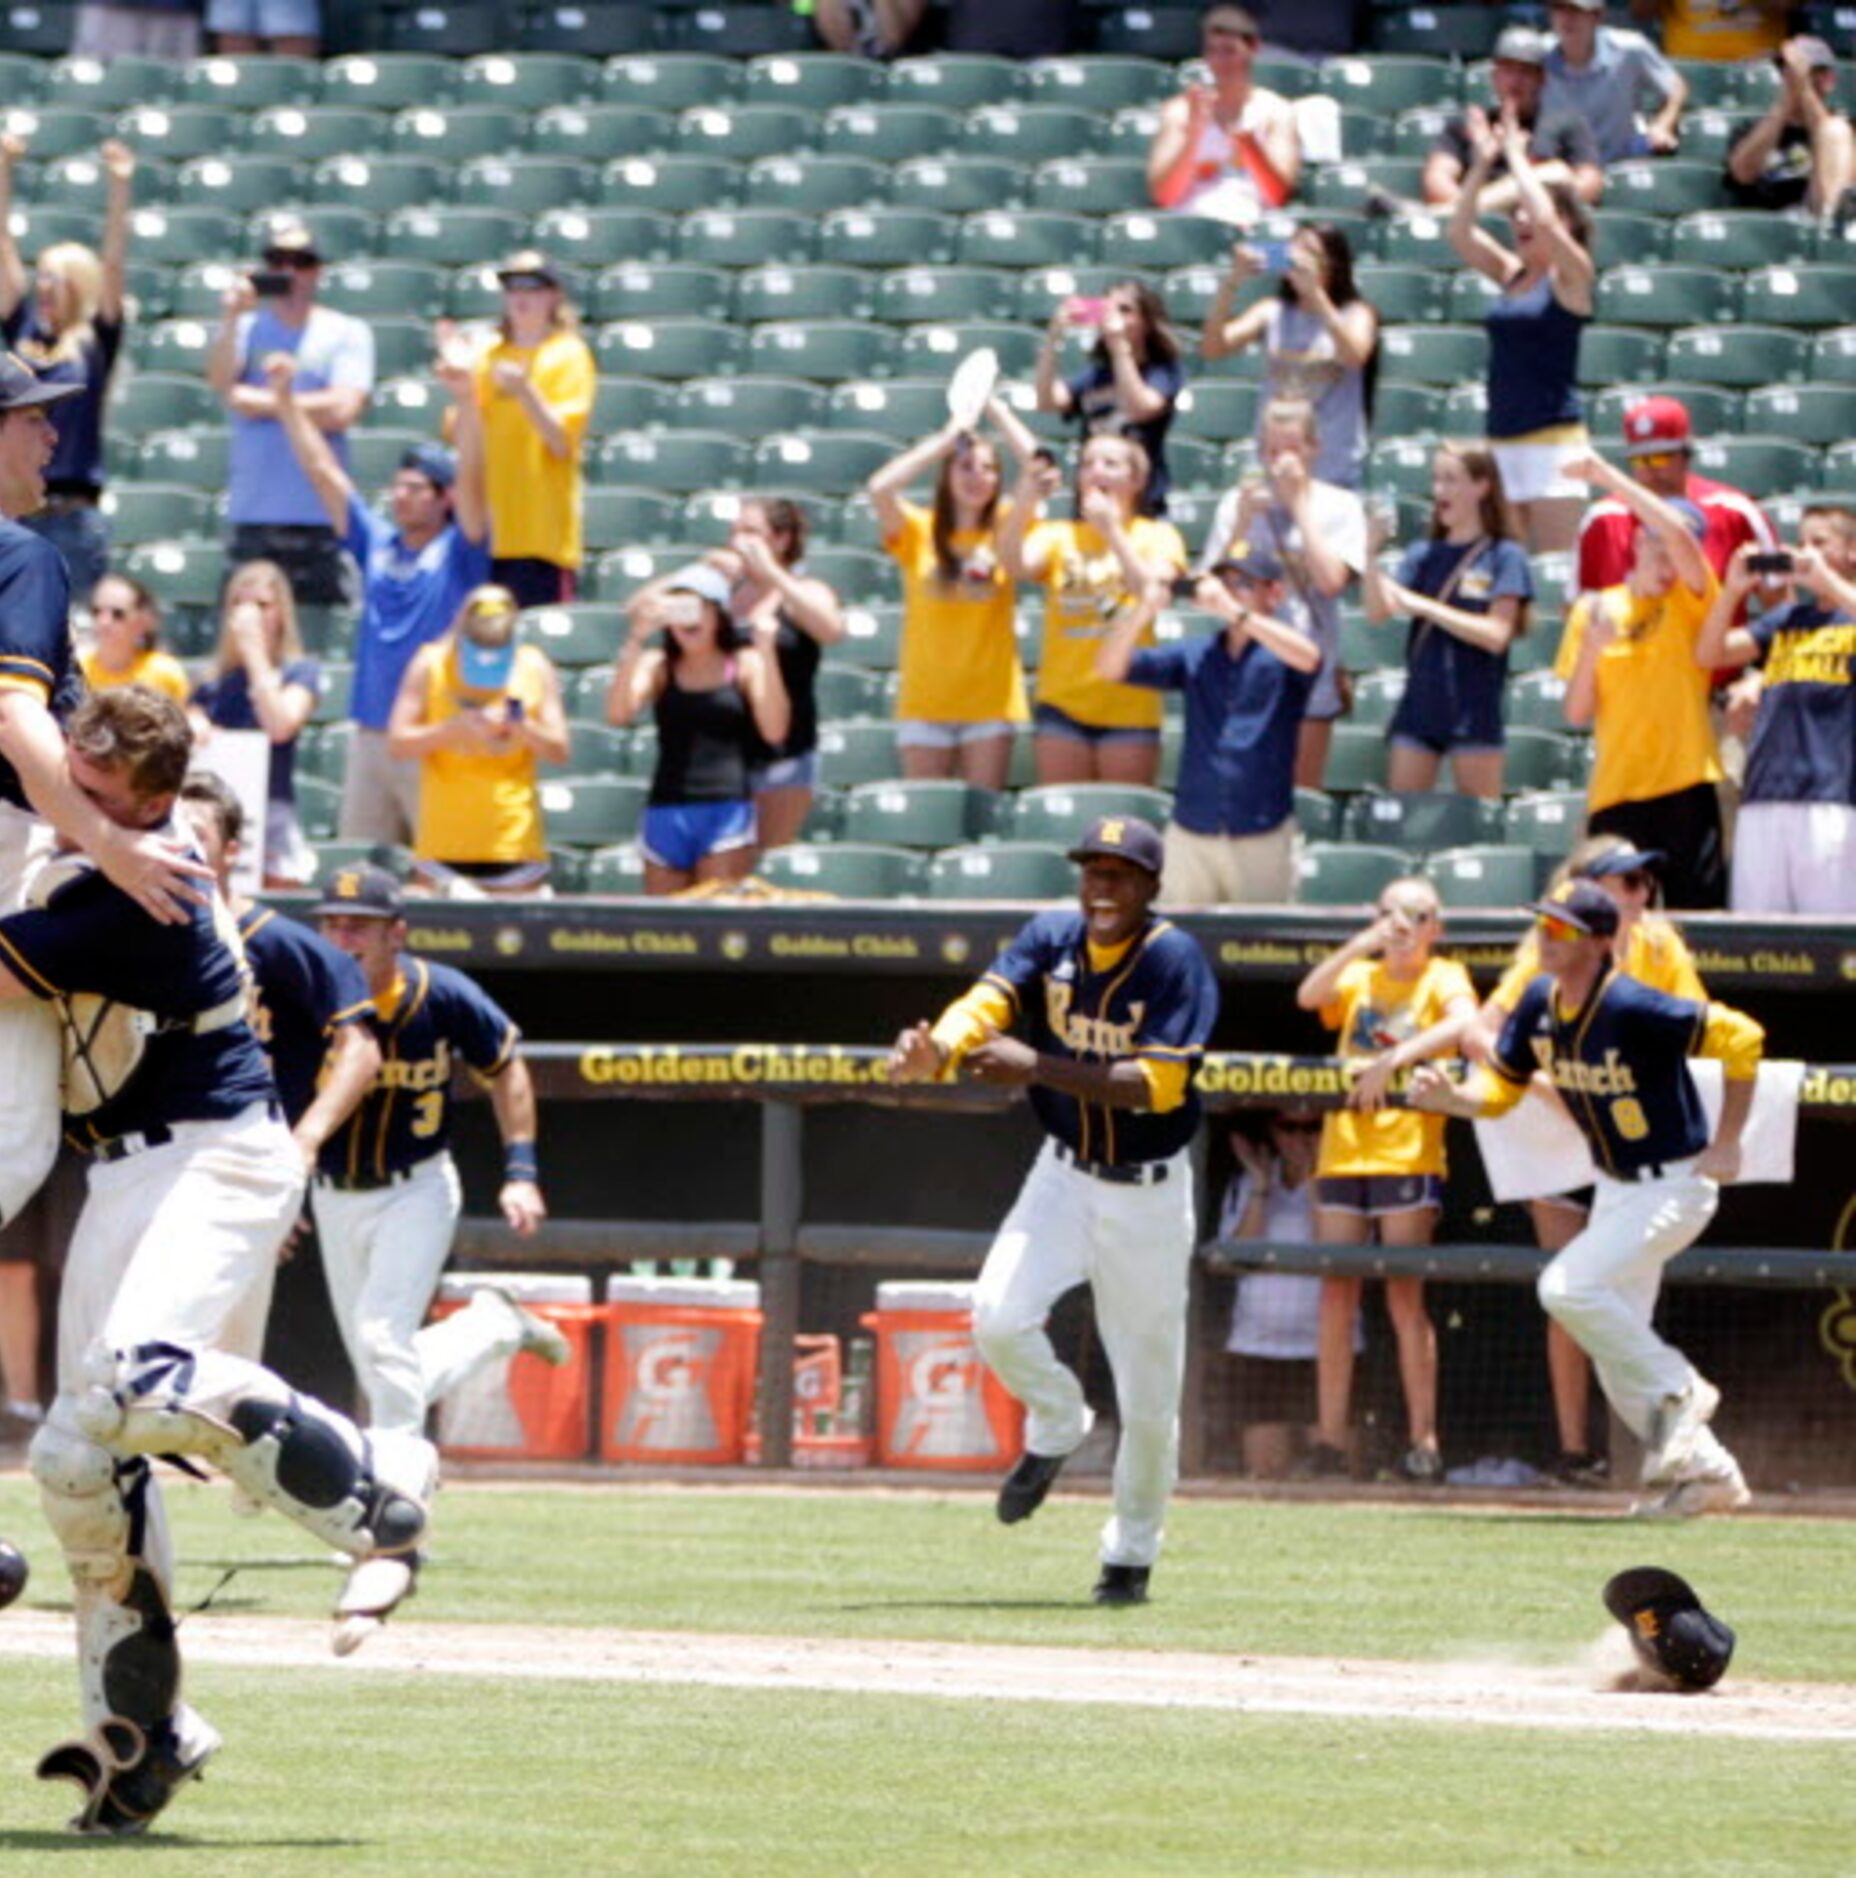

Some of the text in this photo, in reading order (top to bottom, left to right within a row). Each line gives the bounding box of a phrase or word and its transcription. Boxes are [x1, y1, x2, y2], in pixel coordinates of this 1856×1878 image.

[550, 928, 699, 955] Golden Chick
[770, 932, 919, 958] Golden Chick
[410, 1090, 443, 1138] 3
